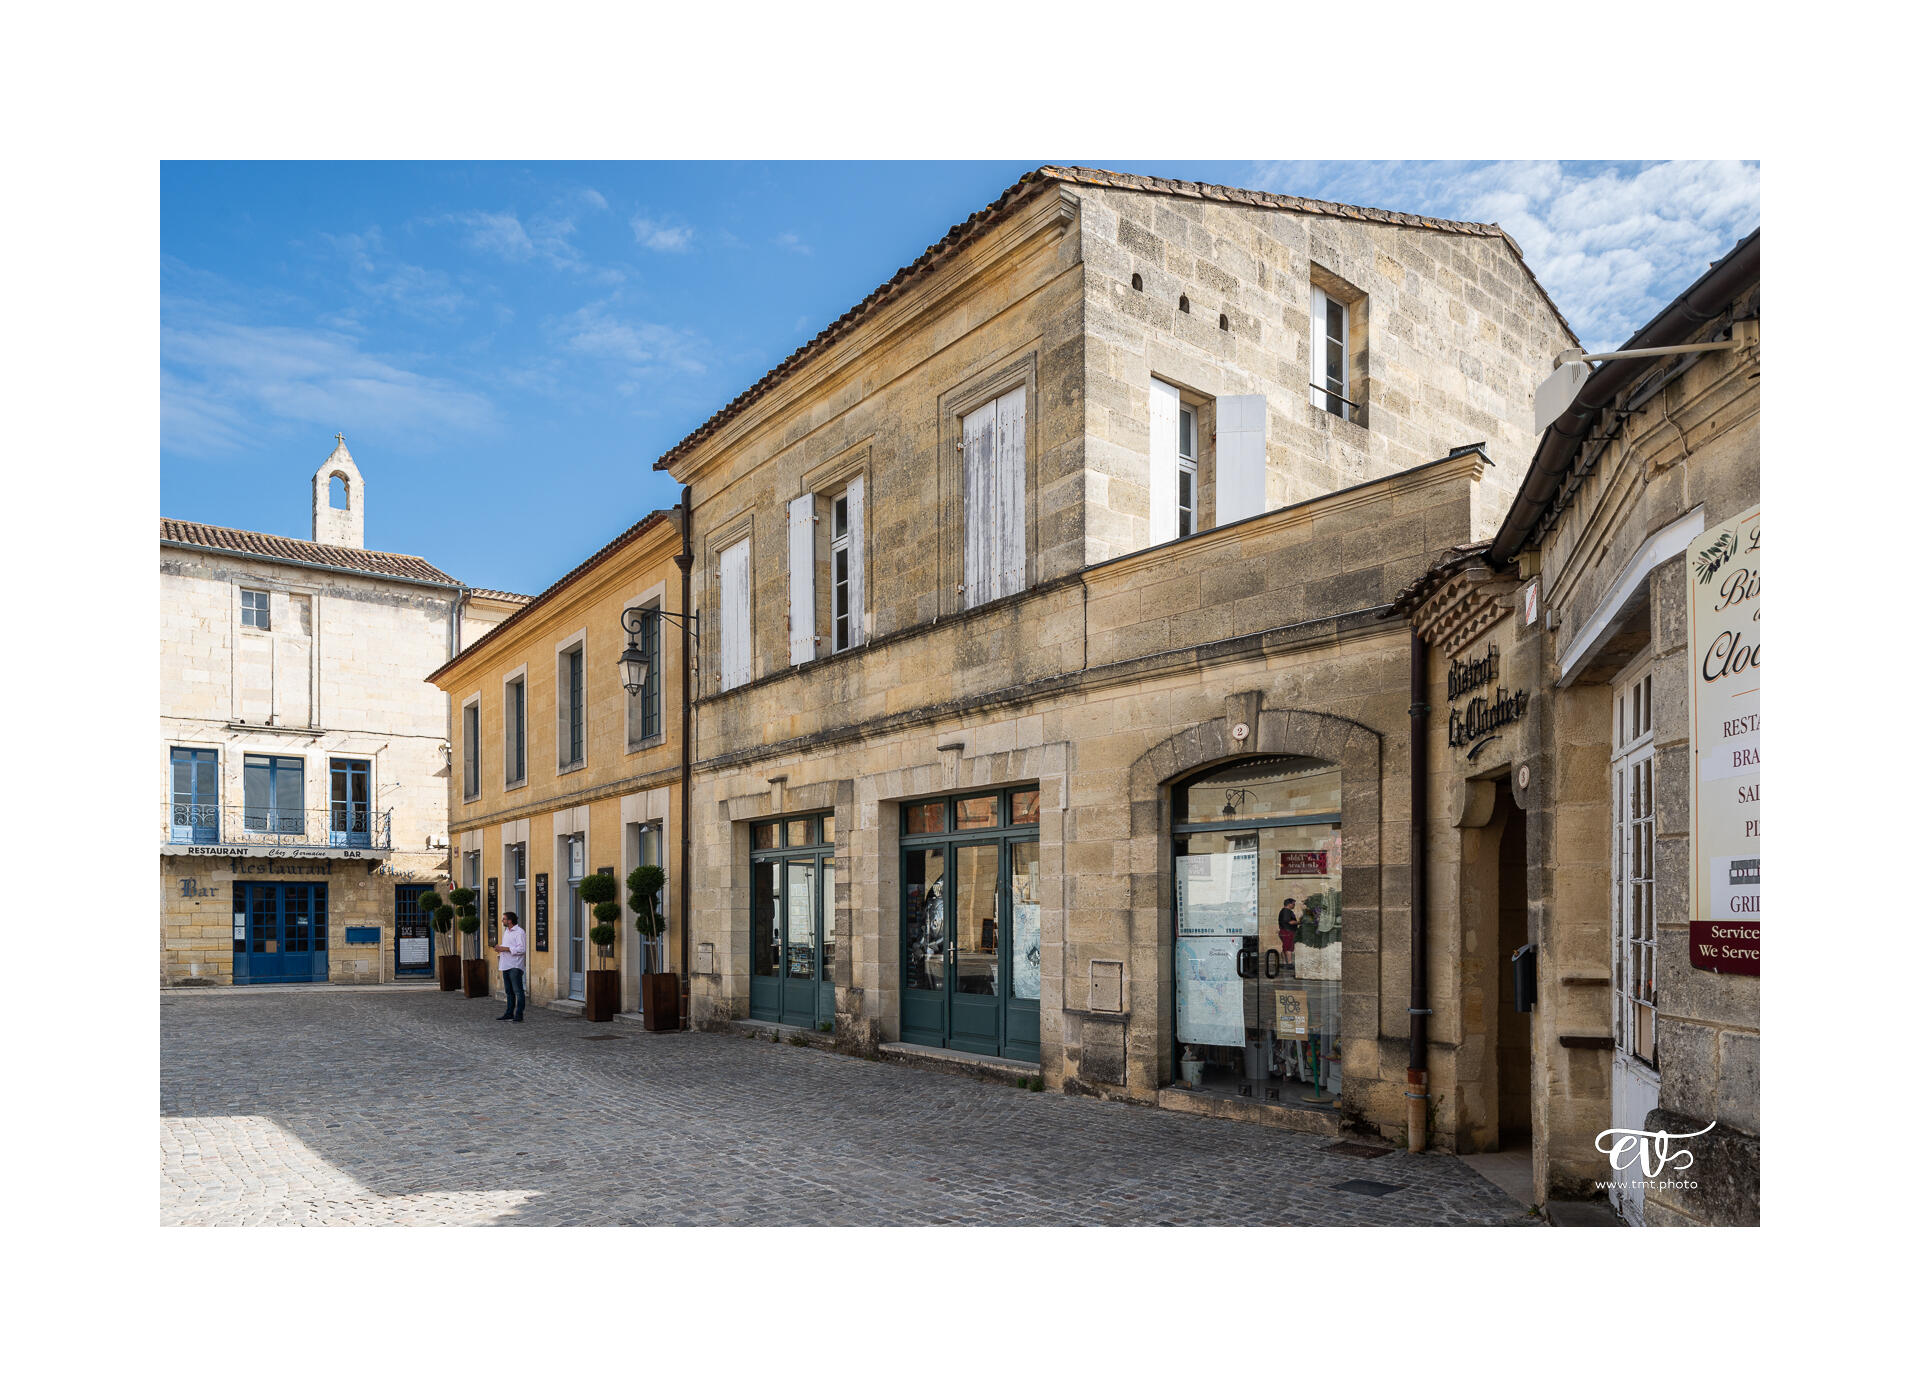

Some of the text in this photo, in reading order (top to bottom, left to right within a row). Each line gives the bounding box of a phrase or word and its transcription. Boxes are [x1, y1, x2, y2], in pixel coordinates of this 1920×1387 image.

[188, 847, 361, 858] RESTAURANT Chez Germaine BAR
[179, 877, 219, 898] Bar
[1711, 926, 1760, 940] Service
[1698, 944, 1760, 960] We Serve
